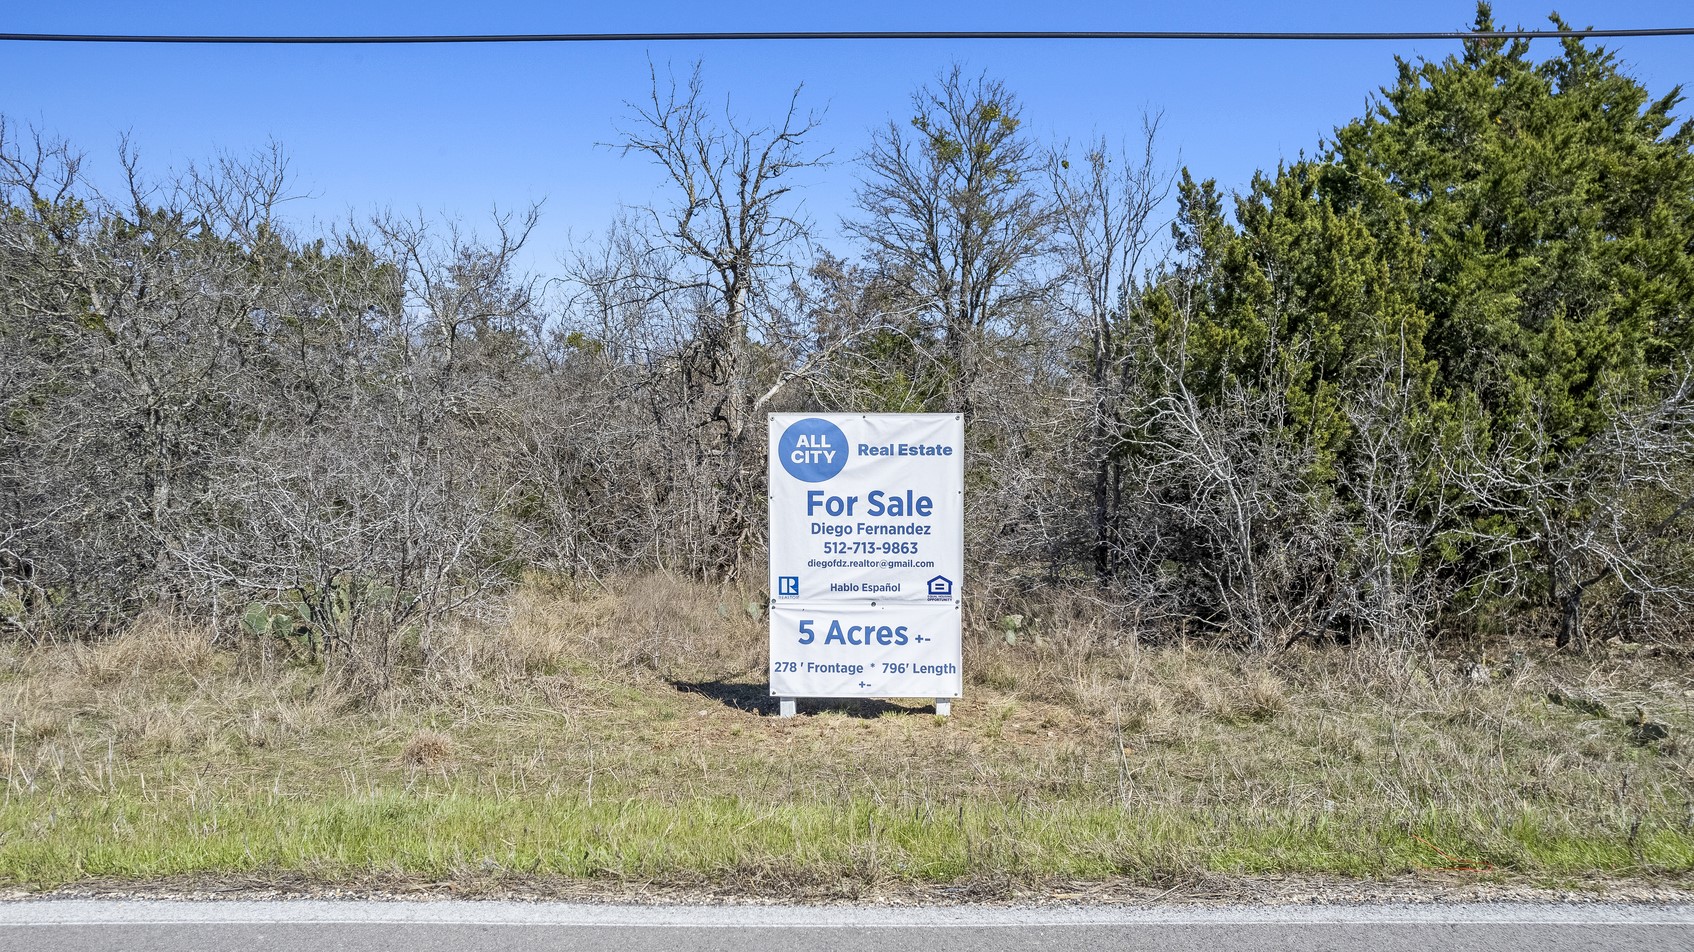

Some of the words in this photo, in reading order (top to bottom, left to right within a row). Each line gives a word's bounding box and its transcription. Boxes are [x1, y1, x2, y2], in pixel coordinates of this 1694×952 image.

[796, 434, 832, 448] ALL
[857, 443, 894, 456] Real
[898, 443, 953, 456] Estate
[790, 450, 836, 464] CITY
[806, 490, 858, 517] For
[867, 489, 934, 517] Sale
[811, 522, 853, 537] Diego
[857, 522, 932, 535] Fernandez
[823, 541, 919, 554] 512-713-9863
[807, 559, 935, 568] diegofdz.realtor@gmail.com
[830, 583, 860, 592] Hablo
[862, 583, 901, 593] Español
[798, 620, 815, 645] 5
[824, 620, 909, 645] Acres
[807, 662, 864, 675] Frontage
[912, 663, 956, 675] Length
